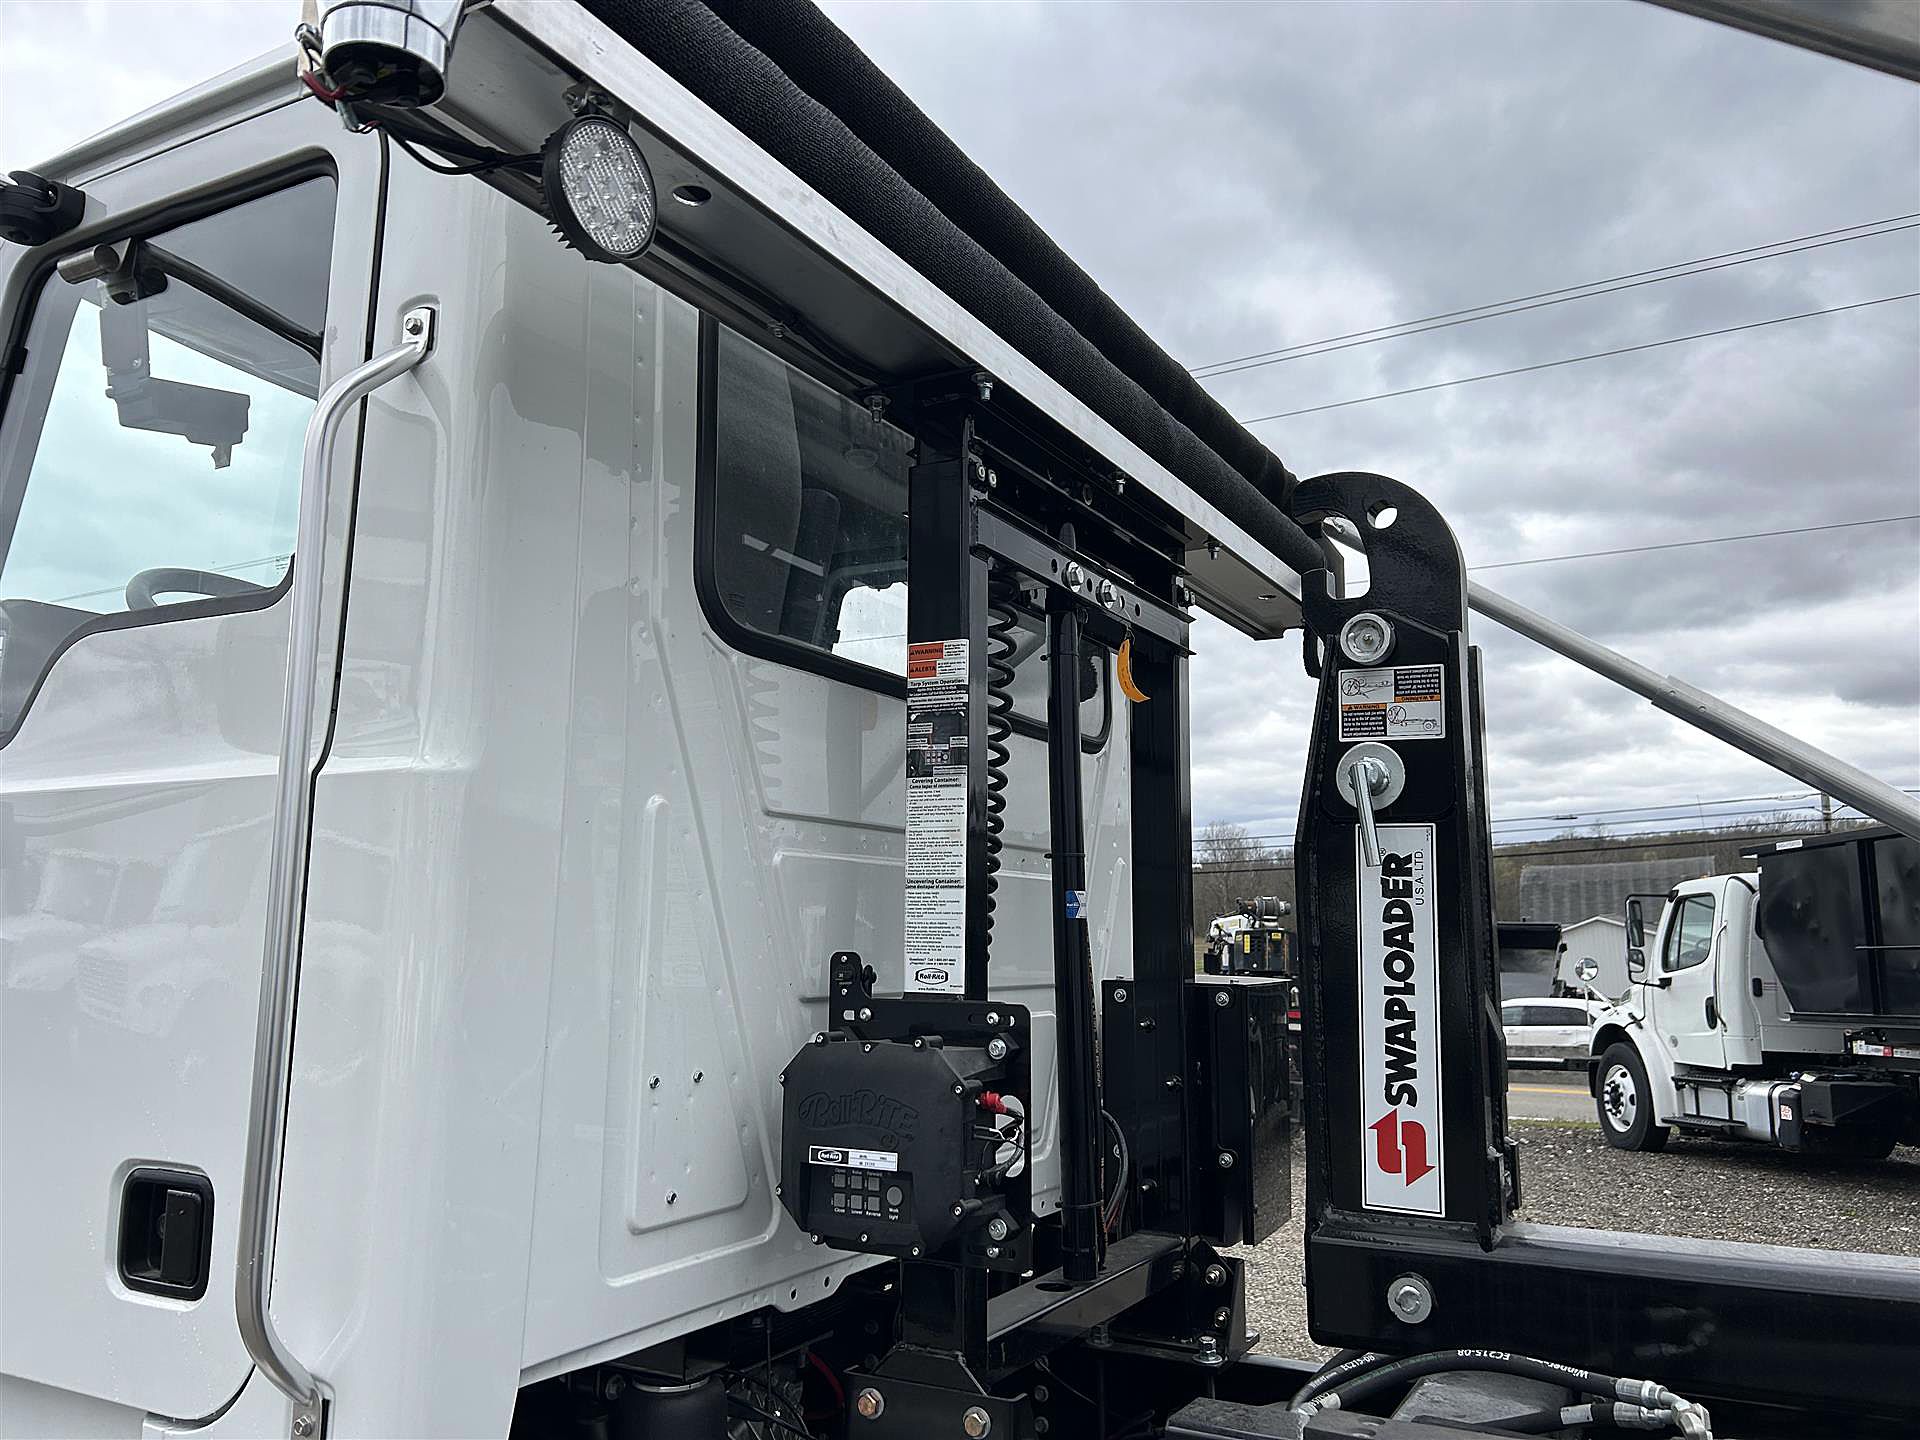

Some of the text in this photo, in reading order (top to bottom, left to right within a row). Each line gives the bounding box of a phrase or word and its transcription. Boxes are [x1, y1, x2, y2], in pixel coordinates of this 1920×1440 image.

[914, 647, 943, 655] WARNING
[1414, 848, 1425, 905] U.S.A. LTD.
[1380, 853, 1417, 1107] SWAPLOADER
[1548, 1362, 1589, 1379] Winner
